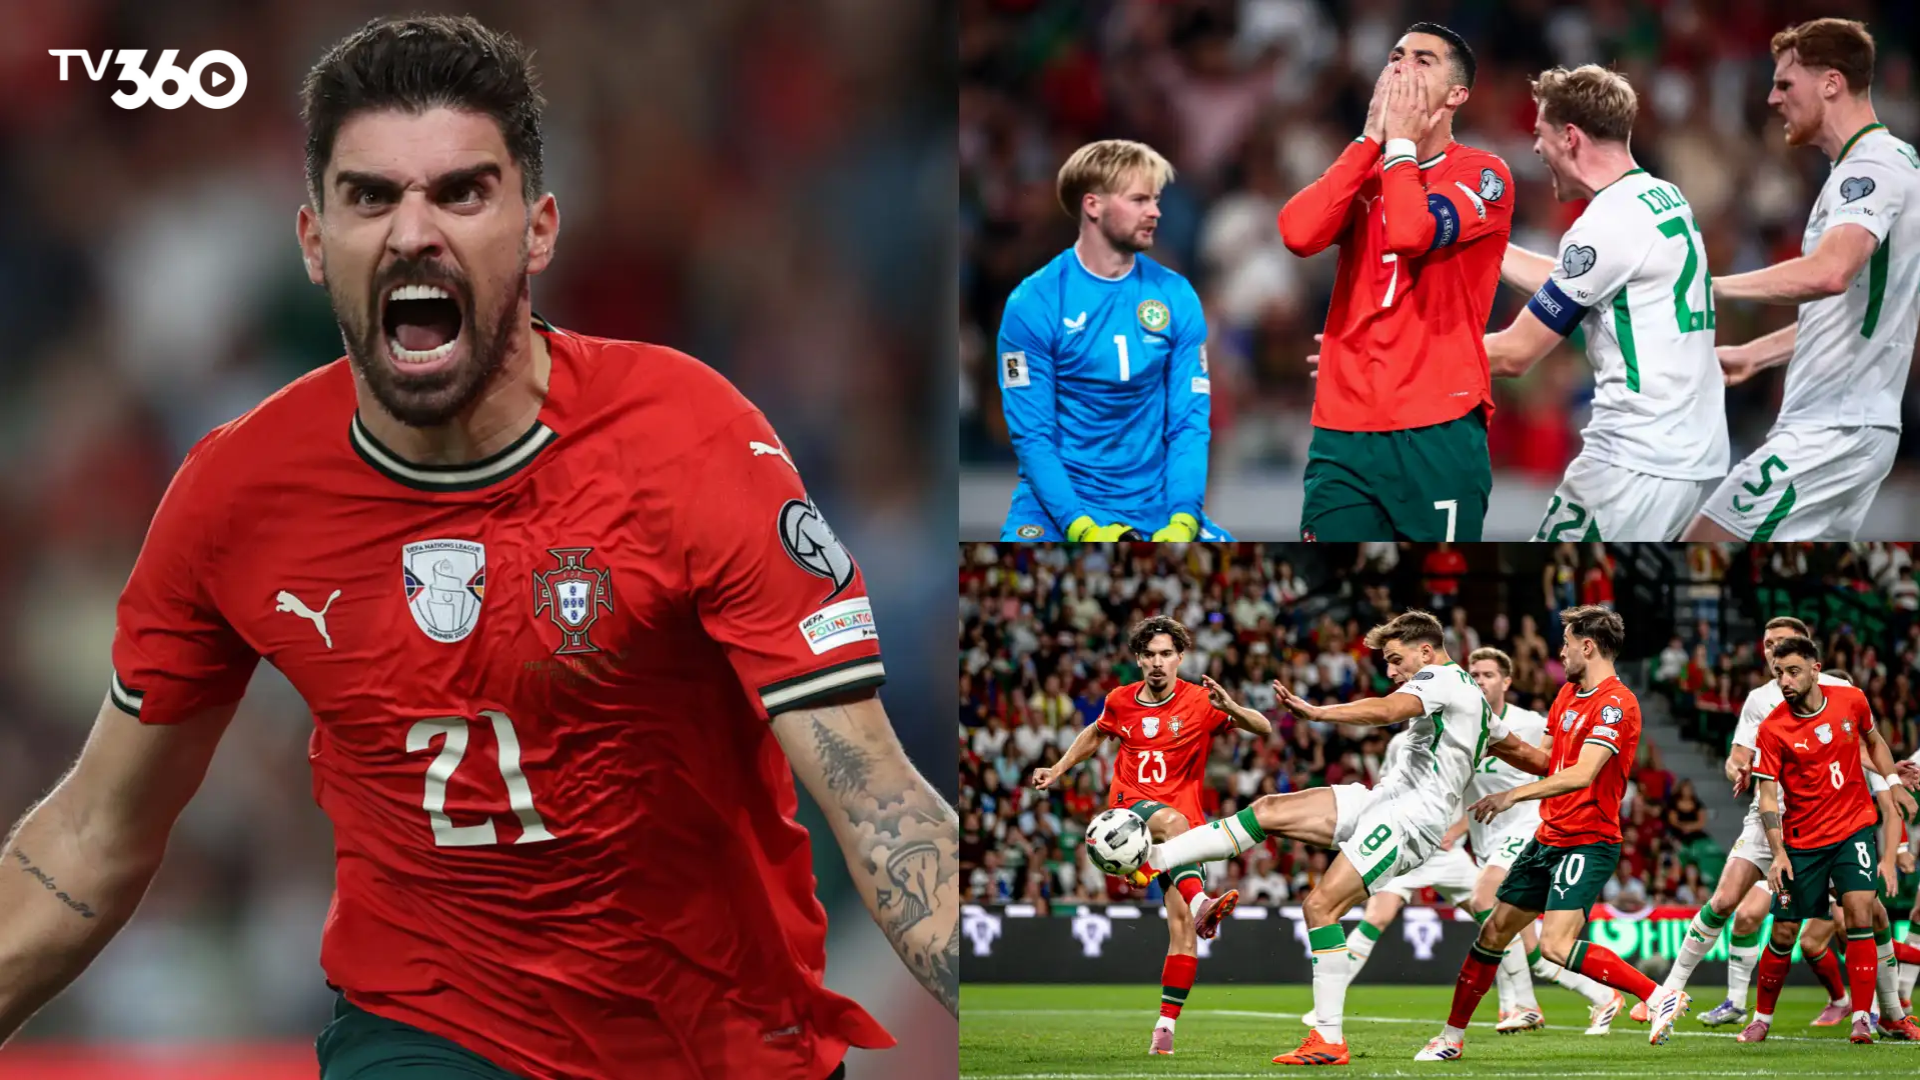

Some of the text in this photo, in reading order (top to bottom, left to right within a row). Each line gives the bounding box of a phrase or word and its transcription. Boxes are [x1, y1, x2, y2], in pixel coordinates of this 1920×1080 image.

[1381, 253, 1398, 307] 7
[1113, 335, 1130, 381] 1
[1742, 454, 1789, 496] 5
[1434, 499, 1458, 542] 7
[406, 545, 423, 553] UEFA
[455, 542, 481, 553] LEAGUE
[802, 613, 824, 629] UEFA
[406, 710, 557, 846] 21
[1138, 750, 1166, 783] 23
[1829, 760, 1845, 790] 8
[1363, 823, 1392, 851] 8
[1553, 853, 1586, 886] 10
[1855, 841, 1871, 869] 8
